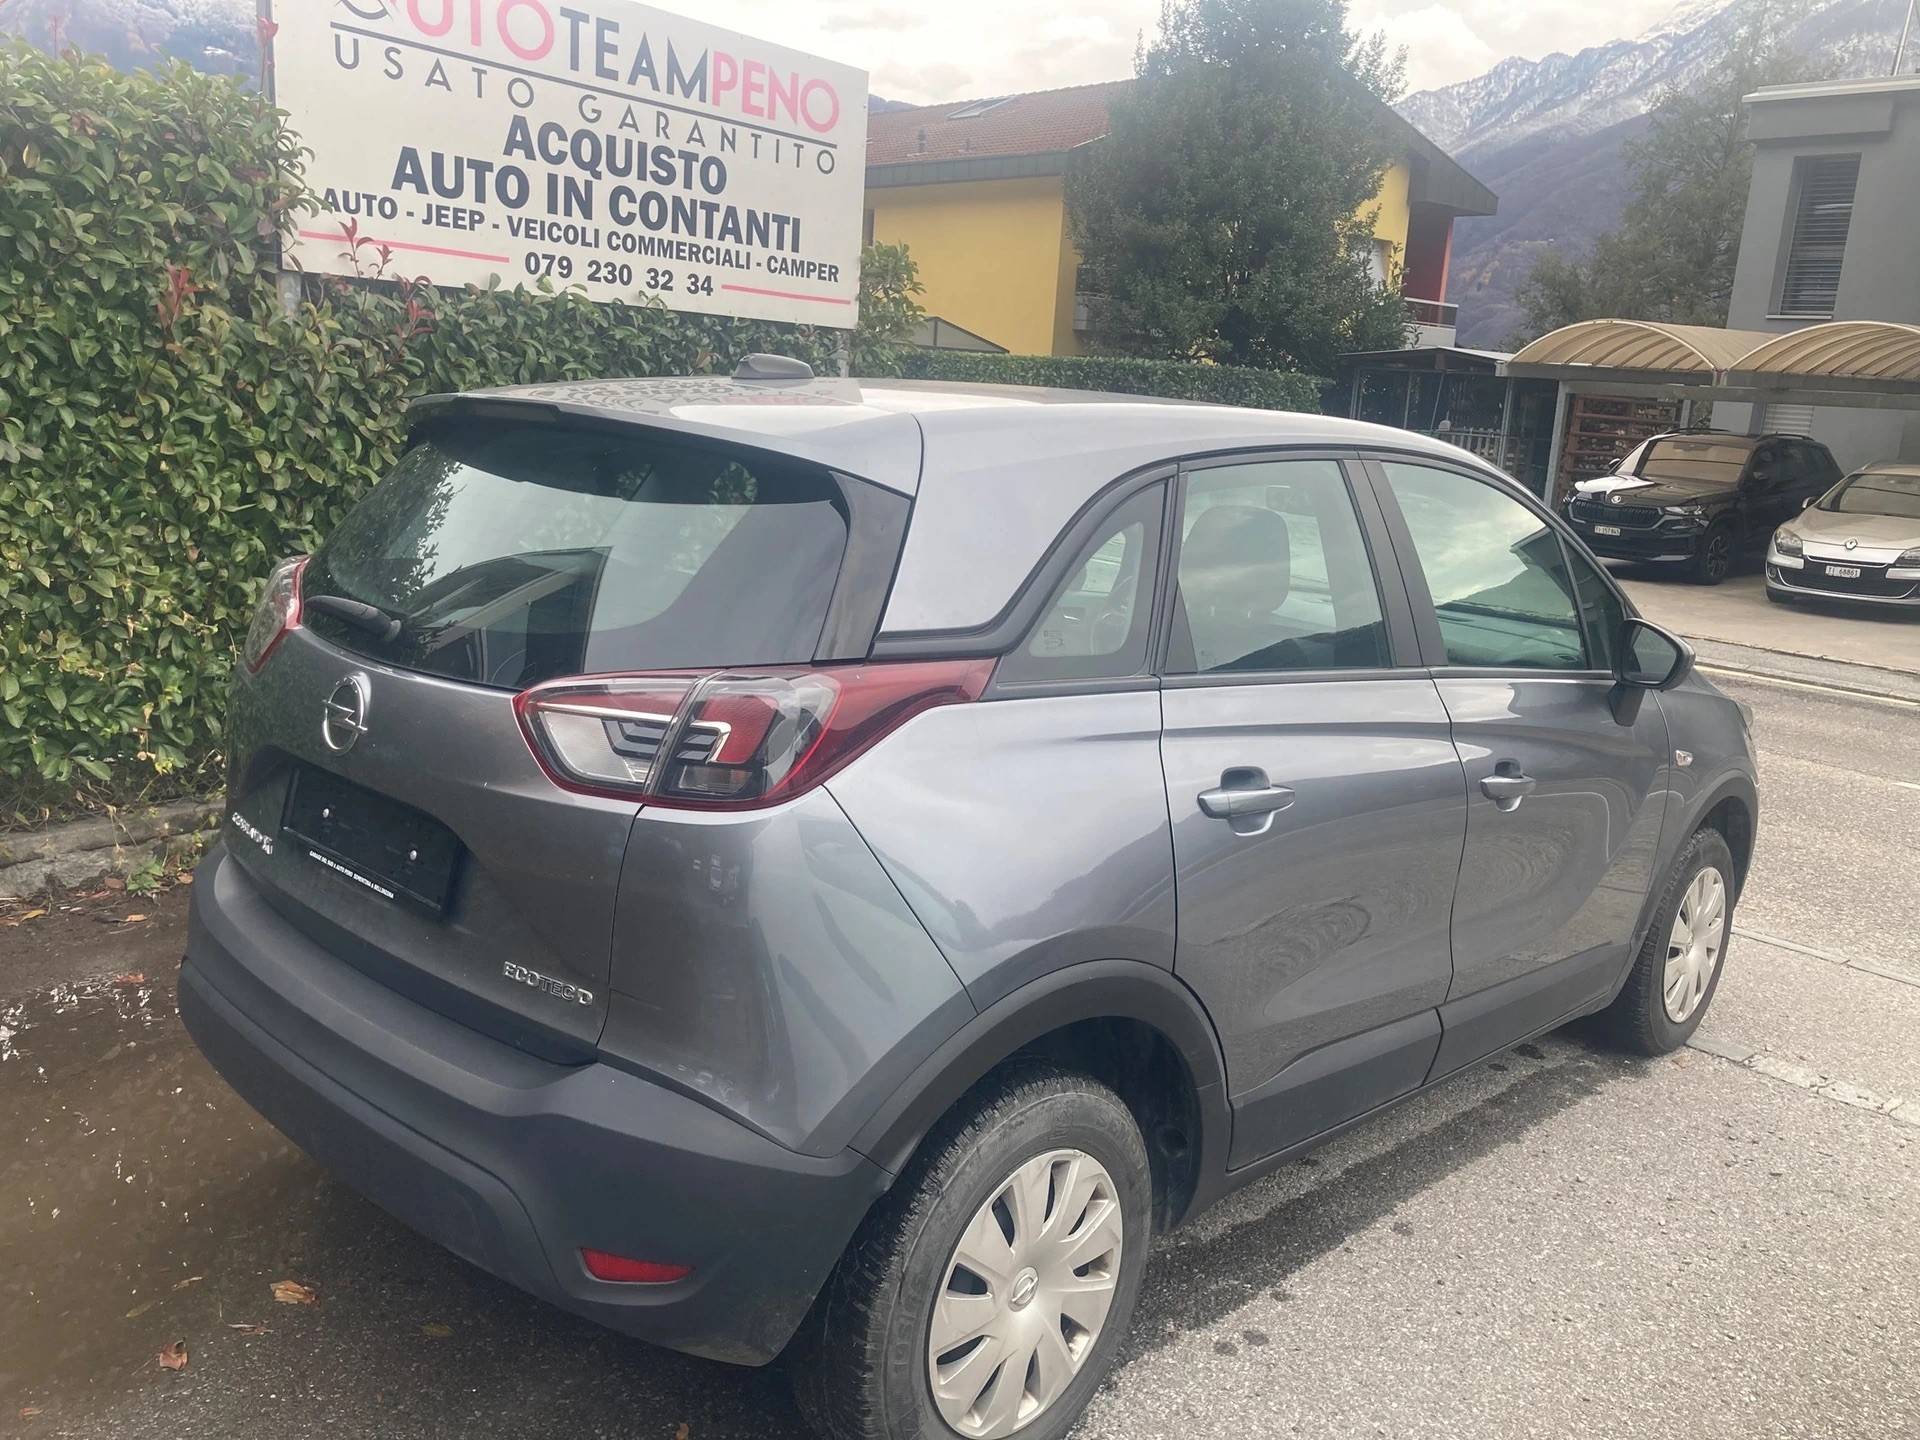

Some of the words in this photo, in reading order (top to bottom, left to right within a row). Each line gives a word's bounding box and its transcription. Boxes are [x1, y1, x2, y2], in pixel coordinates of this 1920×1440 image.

[334, 33, 535, 109] USATO
[578, 93, 836, 175] GARANTITO
[391, 145, 530, 209] AUTO
[547, 172, 593, 221] IN
[608, 185, 801, 254] CONTANTI
[502, 114, 728, 196] ACQUISTO
[323, 187, 398, 220] AUTO
[421, 203, 485, 231] JEEP
[506, 215, 600, 249] VEICOLI
[606, 230, 751, 270] COMMERCIALI
[766, 255, 840, 283] CAMPER
[524, 251, 573, 279] 079
[587, 259, 633, 287] 230
[646, 267, 675, 292] 32
[686, 273, 714, 297] 34
[504, 960, 576, 1001] ECOTEC
[577, 987, 594, 1006] D
